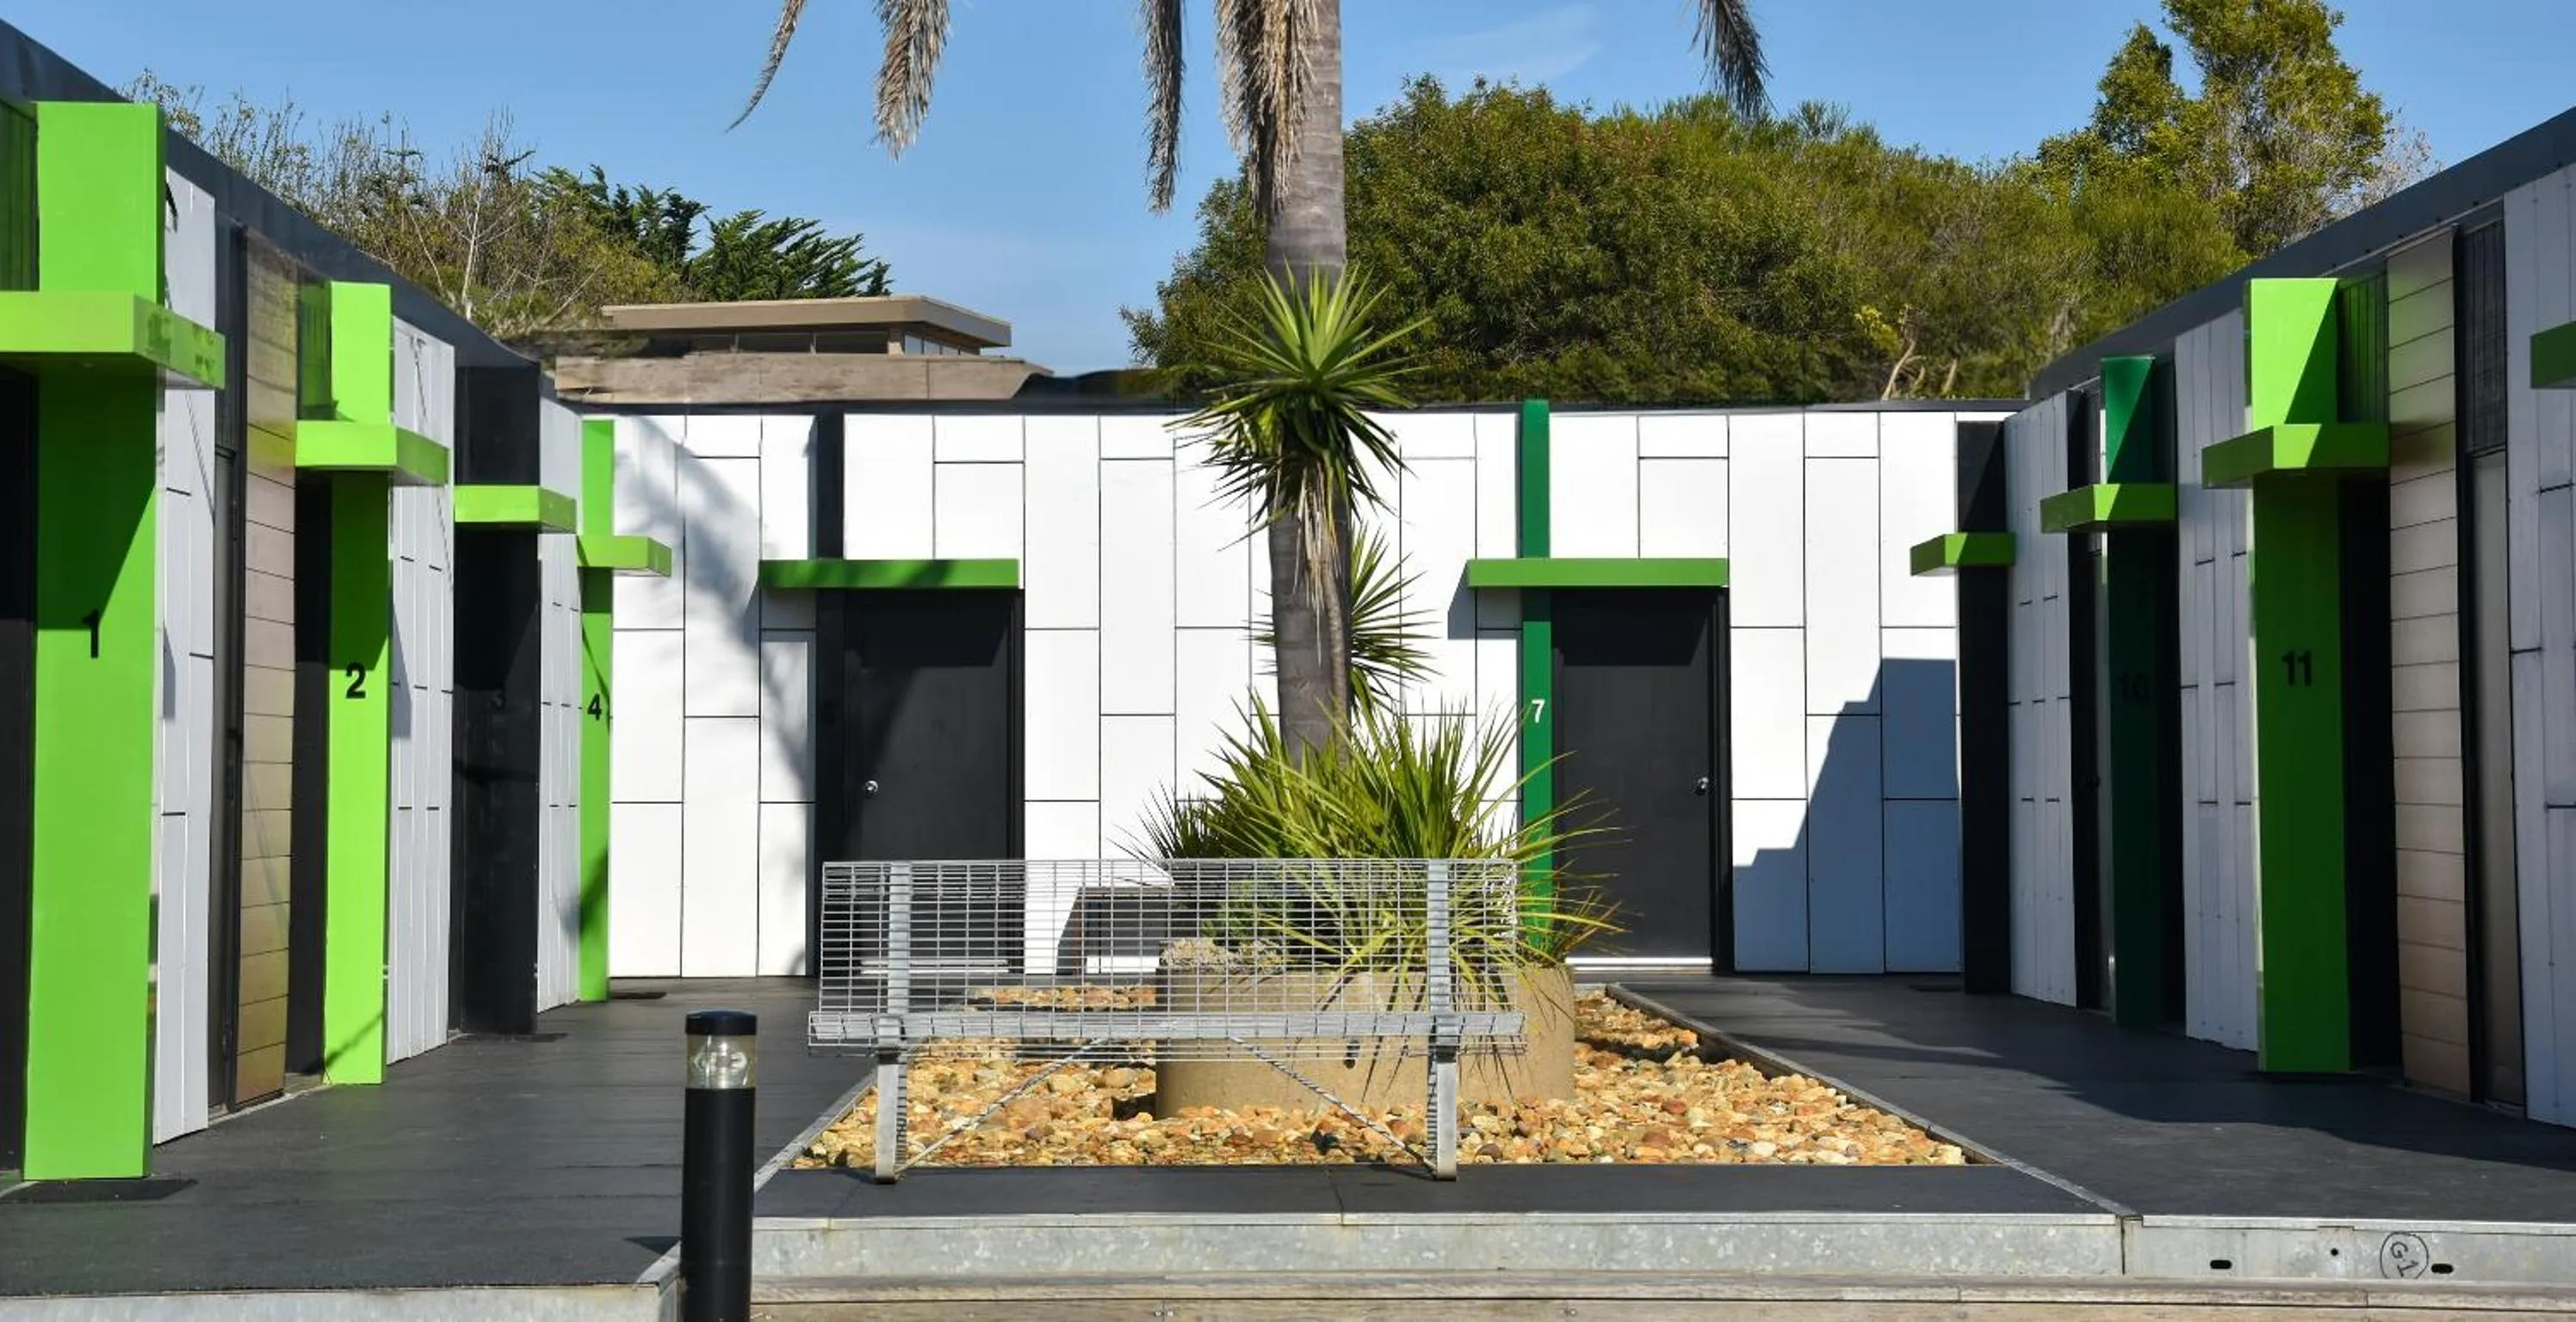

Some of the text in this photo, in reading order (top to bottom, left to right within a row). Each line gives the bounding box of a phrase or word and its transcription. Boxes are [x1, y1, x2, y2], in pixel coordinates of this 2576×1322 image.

[82, 608, 98, 658] 1
[345, 661, 366, 699] 2
[2282, 649, 2312, 687] 11
[2115, 670, 2149, 703] 10
[587, 693, 602, 720] 4
[1532, 699, 1545, 723] 7
